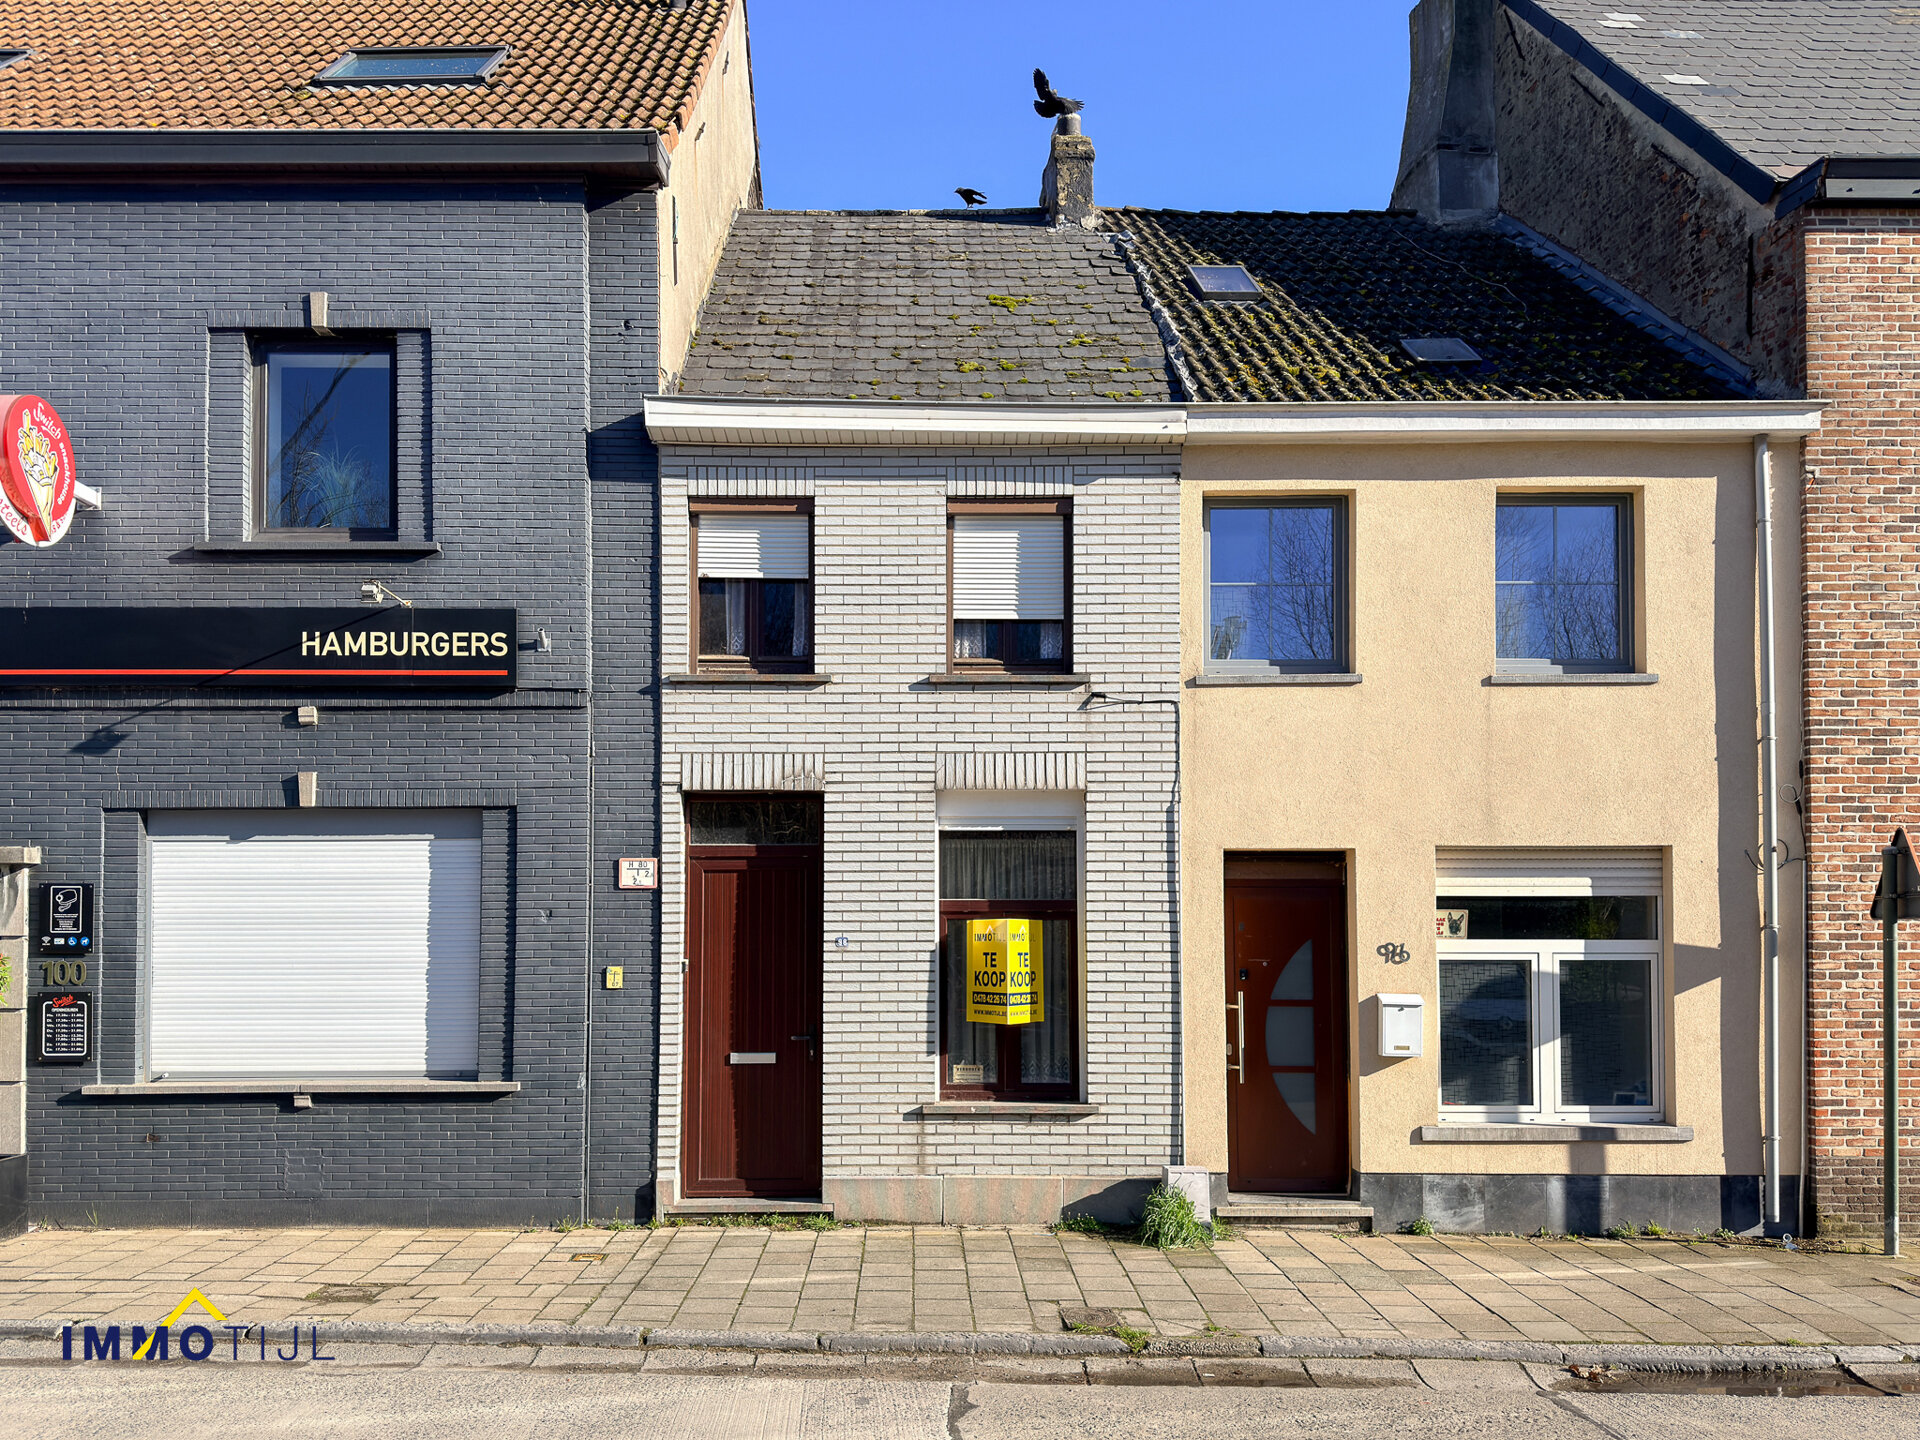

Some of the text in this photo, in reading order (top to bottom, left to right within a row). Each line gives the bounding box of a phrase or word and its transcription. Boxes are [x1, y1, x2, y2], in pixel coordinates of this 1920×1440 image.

[33, 402, 61, 439] Switch
[57, 442, 71, 505] snackhouse
[301, 631, 508, 657] HAMBURGERS
[983, 952, 997, 968] TE
[1017, 952, 1029, 968] TE
[42, 960, 86, 985] 100
[974, 971, 1006, 987] KOOP
[1010, 971, 1037, 987] KOOP
